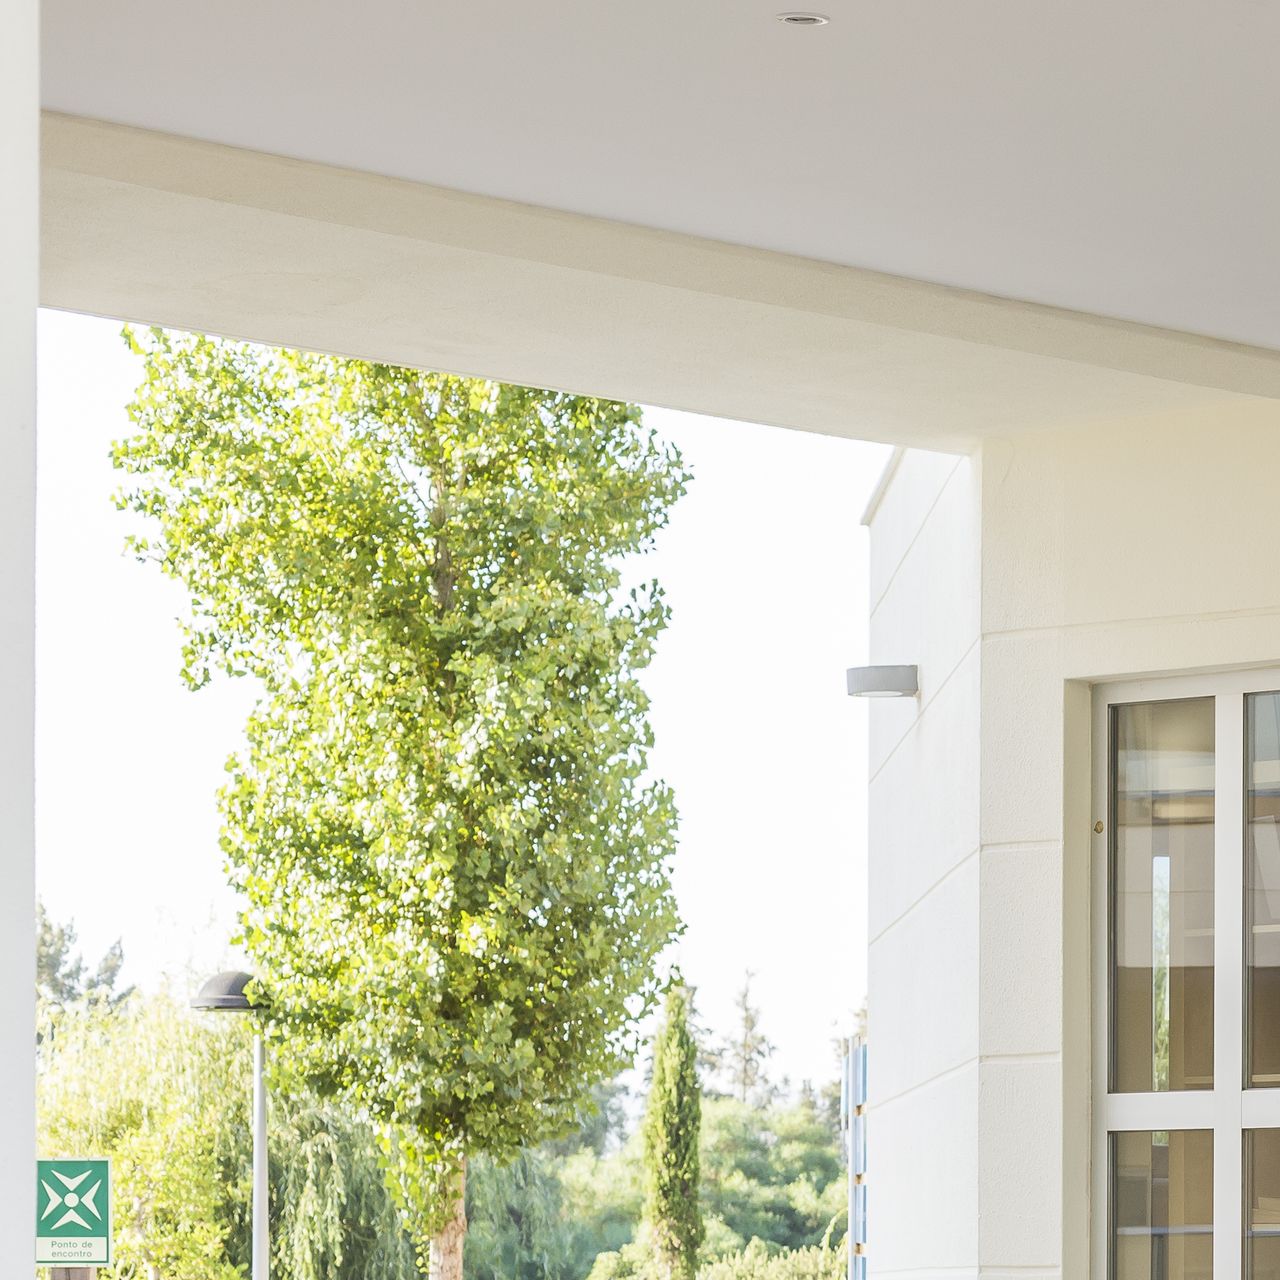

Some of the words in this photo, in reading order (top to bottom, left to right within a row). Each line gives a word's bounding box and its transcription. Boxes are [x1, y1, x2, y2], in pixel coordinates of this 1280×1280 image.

[51, 1240, 78, 1248] Ponto
[81, 1240, 93, 1248] de
[51, 1249, 93, 1258] encontro
